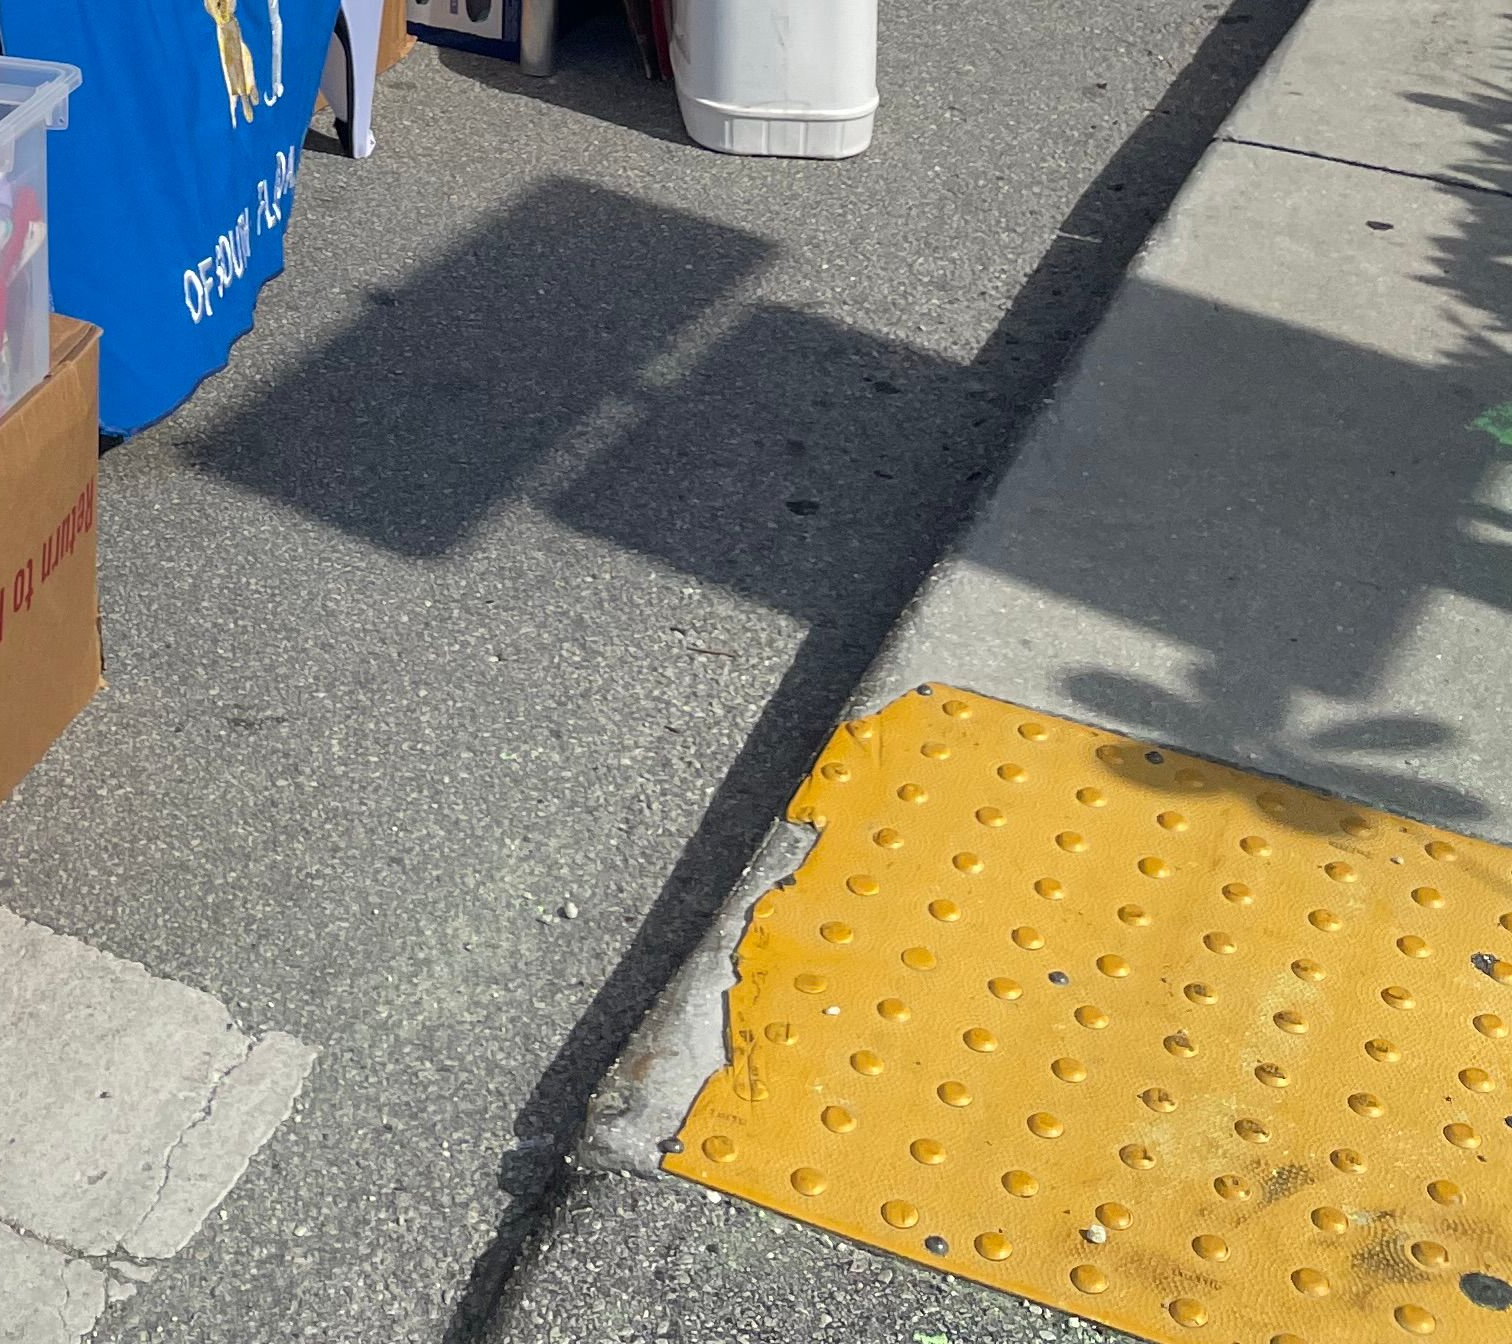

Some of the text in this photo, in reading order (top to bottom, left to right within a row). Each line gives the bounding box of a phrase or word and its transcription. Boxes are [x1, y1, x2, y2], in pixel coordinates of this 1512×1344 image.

[183, 256, 214, 325] OF
[41, 479, 95, 585] Return
[13, 559, 34, 613] to
